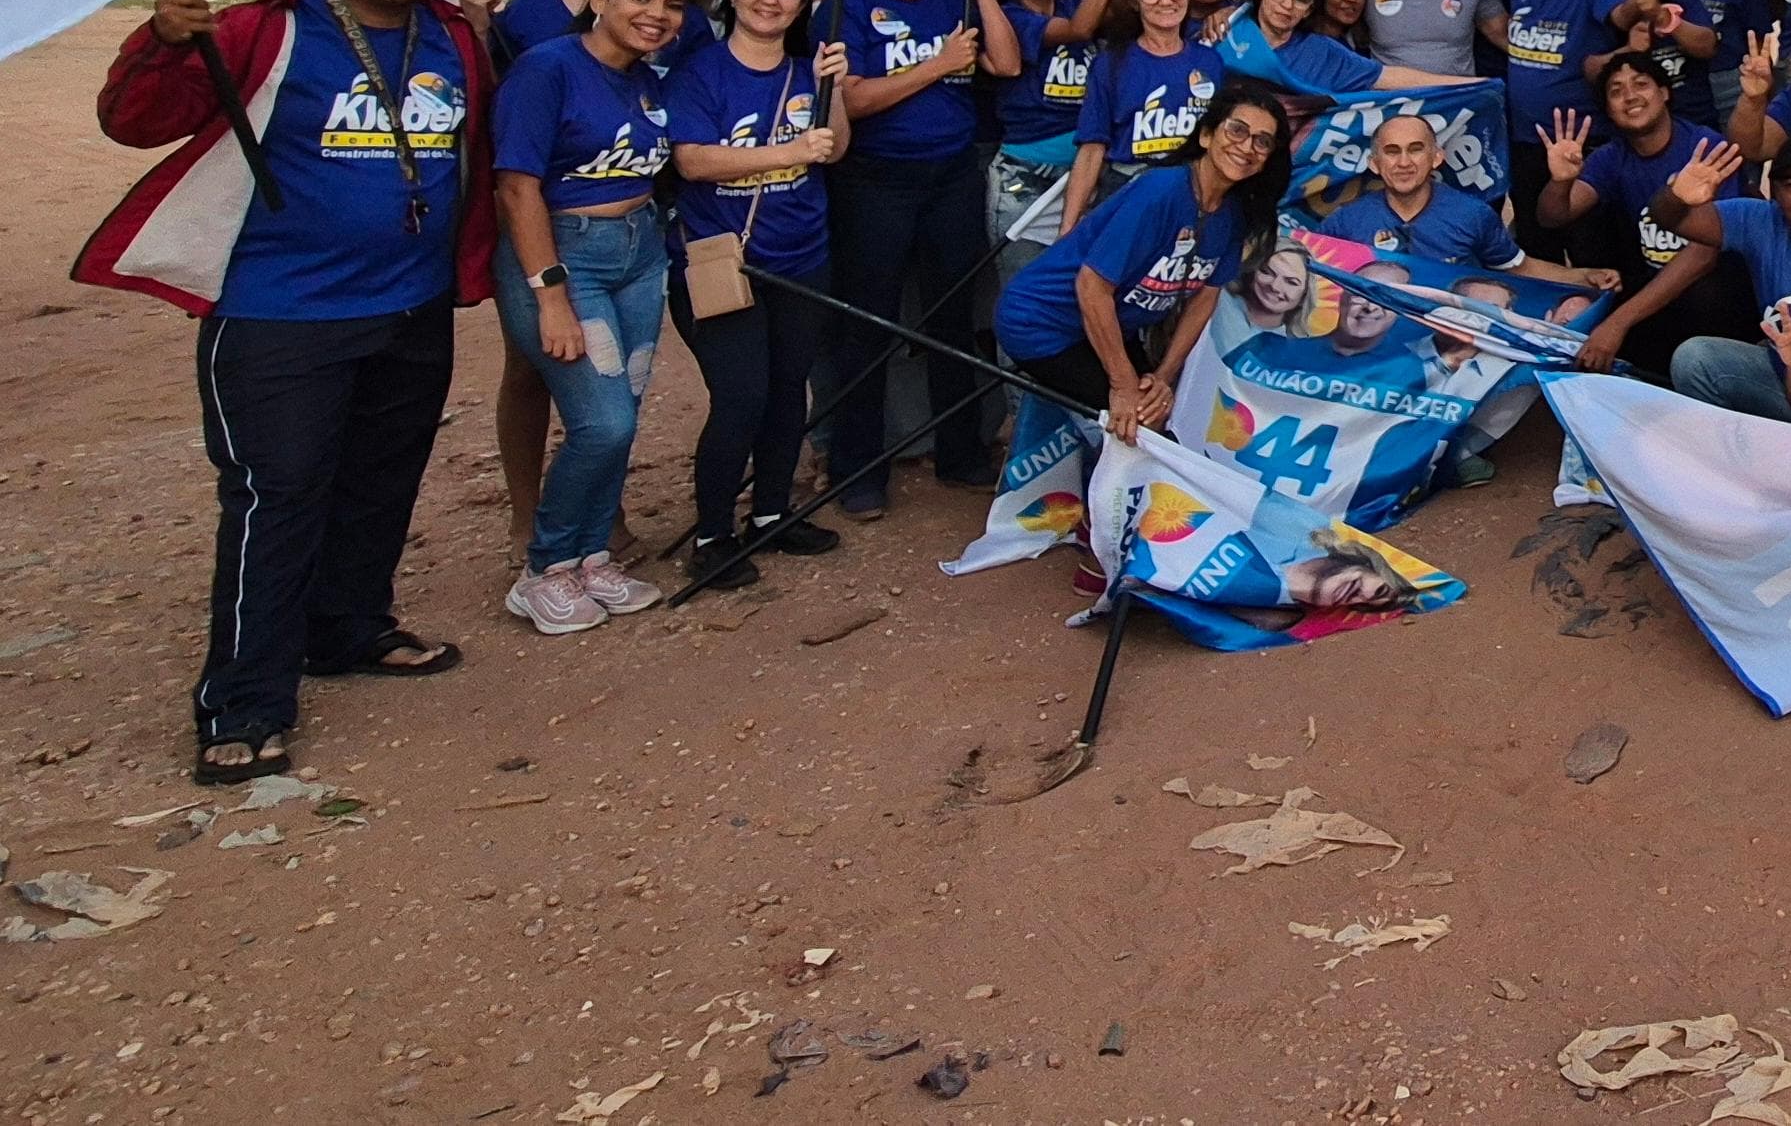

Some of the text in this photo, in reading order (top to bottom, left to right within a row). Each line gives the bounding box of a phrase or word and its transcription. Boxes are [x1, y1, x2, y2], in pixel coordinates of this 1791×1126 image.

[321, 148, 396, 159] Construindo
[1132, 106, 1197, 143] Kleb
[1240, 359, 1463, 423] UNIÃO PRA FAZER
[1010, 424, 1080, 483] UNIÃ
[1235, 415, 1339, 496] 44
